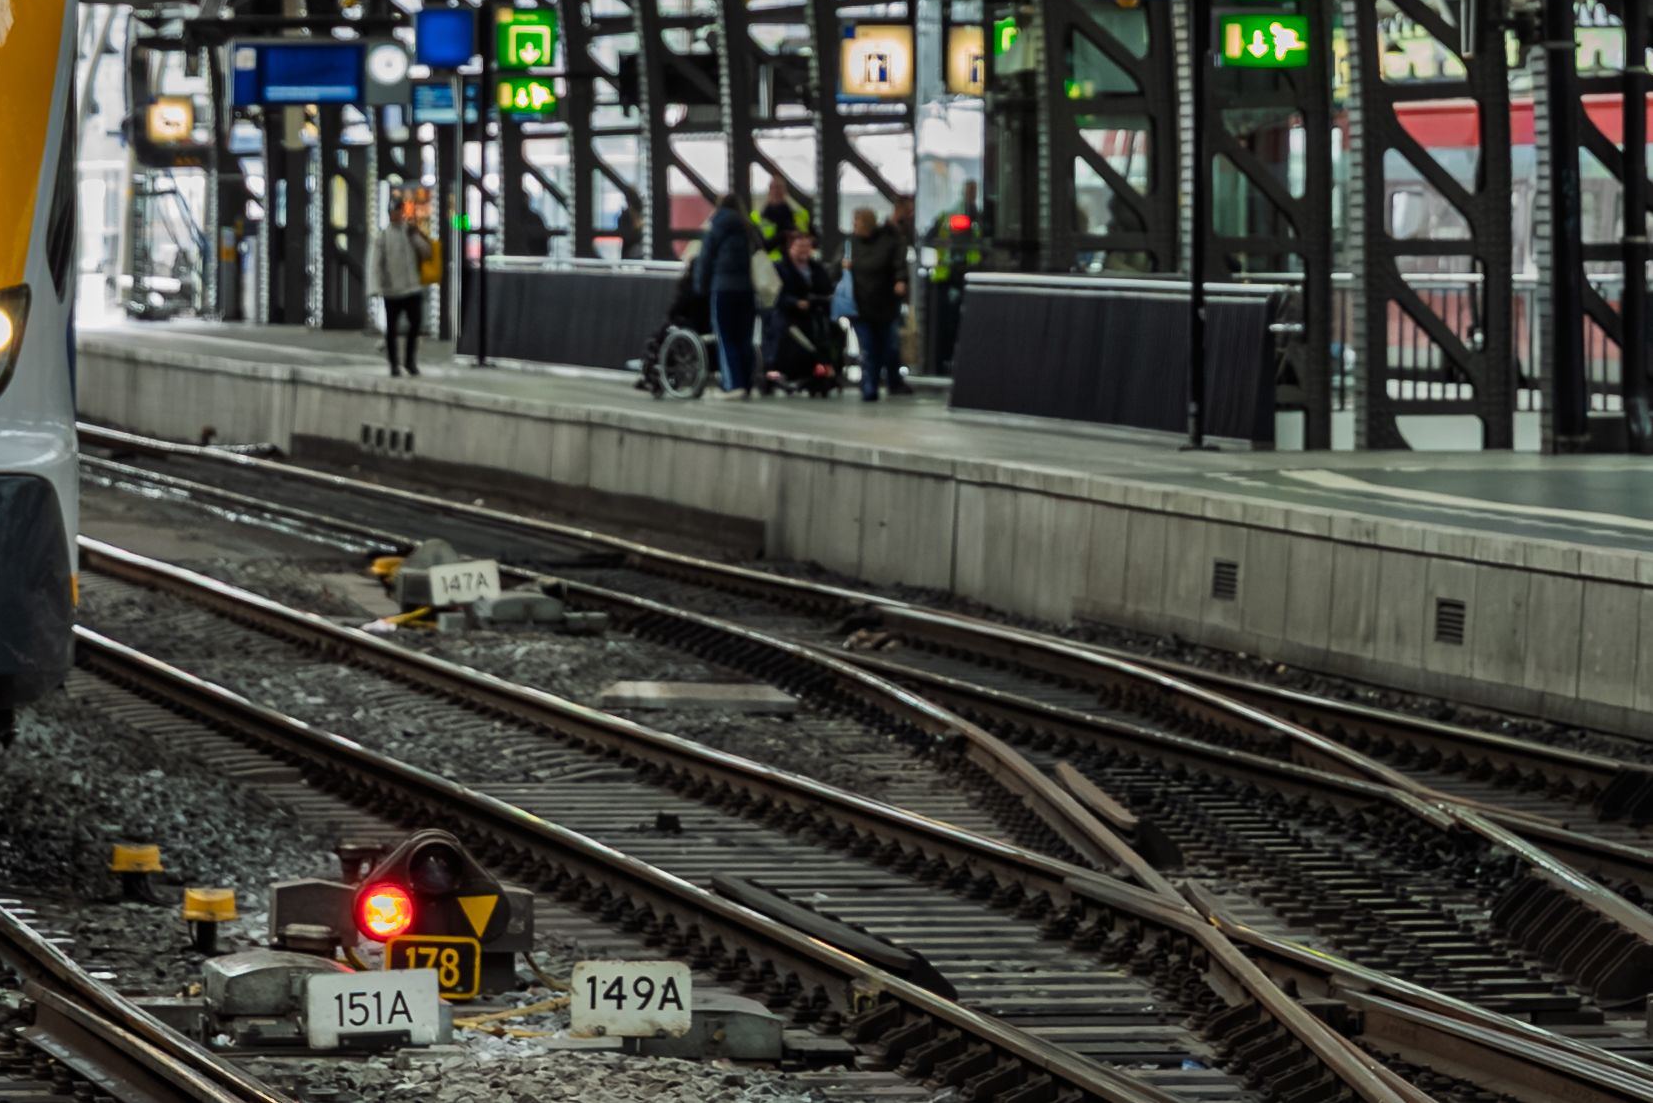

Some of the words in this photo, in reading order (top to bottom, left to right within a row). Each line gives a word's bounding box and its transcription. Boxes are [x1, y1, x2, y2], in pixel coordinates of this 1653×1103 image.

[441, 571, 489, 594] 147A
[406, 947, 460, 988] 178
[334, 990, 413, 1027] 151A
[586, 975, 684, 1010] 149A
